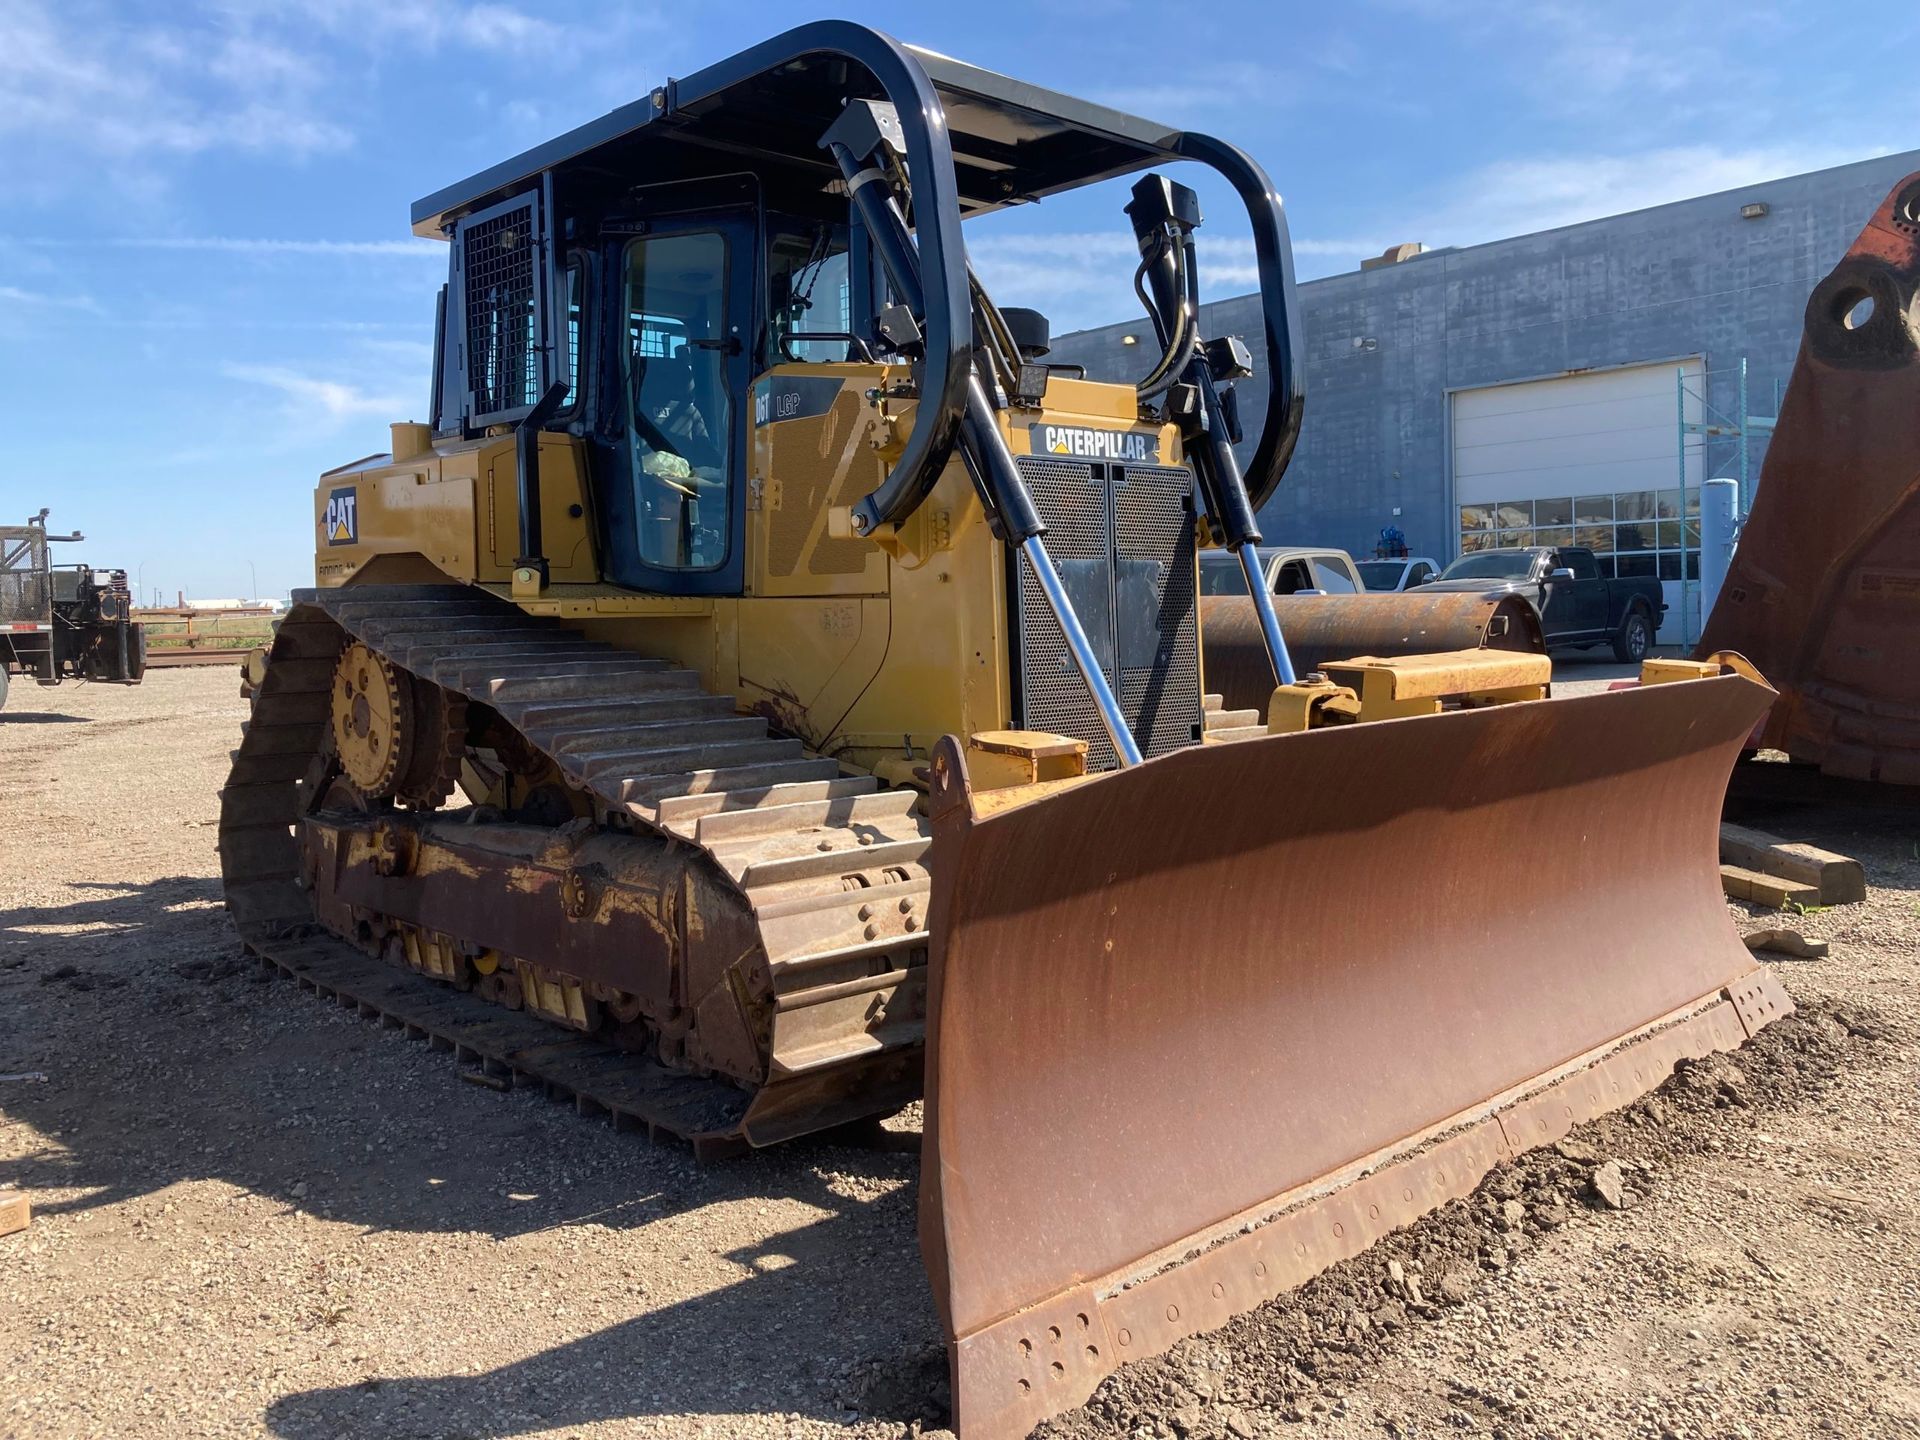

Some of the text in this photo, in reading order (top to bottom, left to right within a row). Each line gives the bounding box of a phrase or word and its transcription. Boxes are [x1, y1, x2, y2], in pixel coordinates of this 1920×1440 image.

[756, 392, 801, 424] D6T LGP
[1045, 426, 1146, 460] CATERPILLAR
[326, 496, 356, 541] CAT
